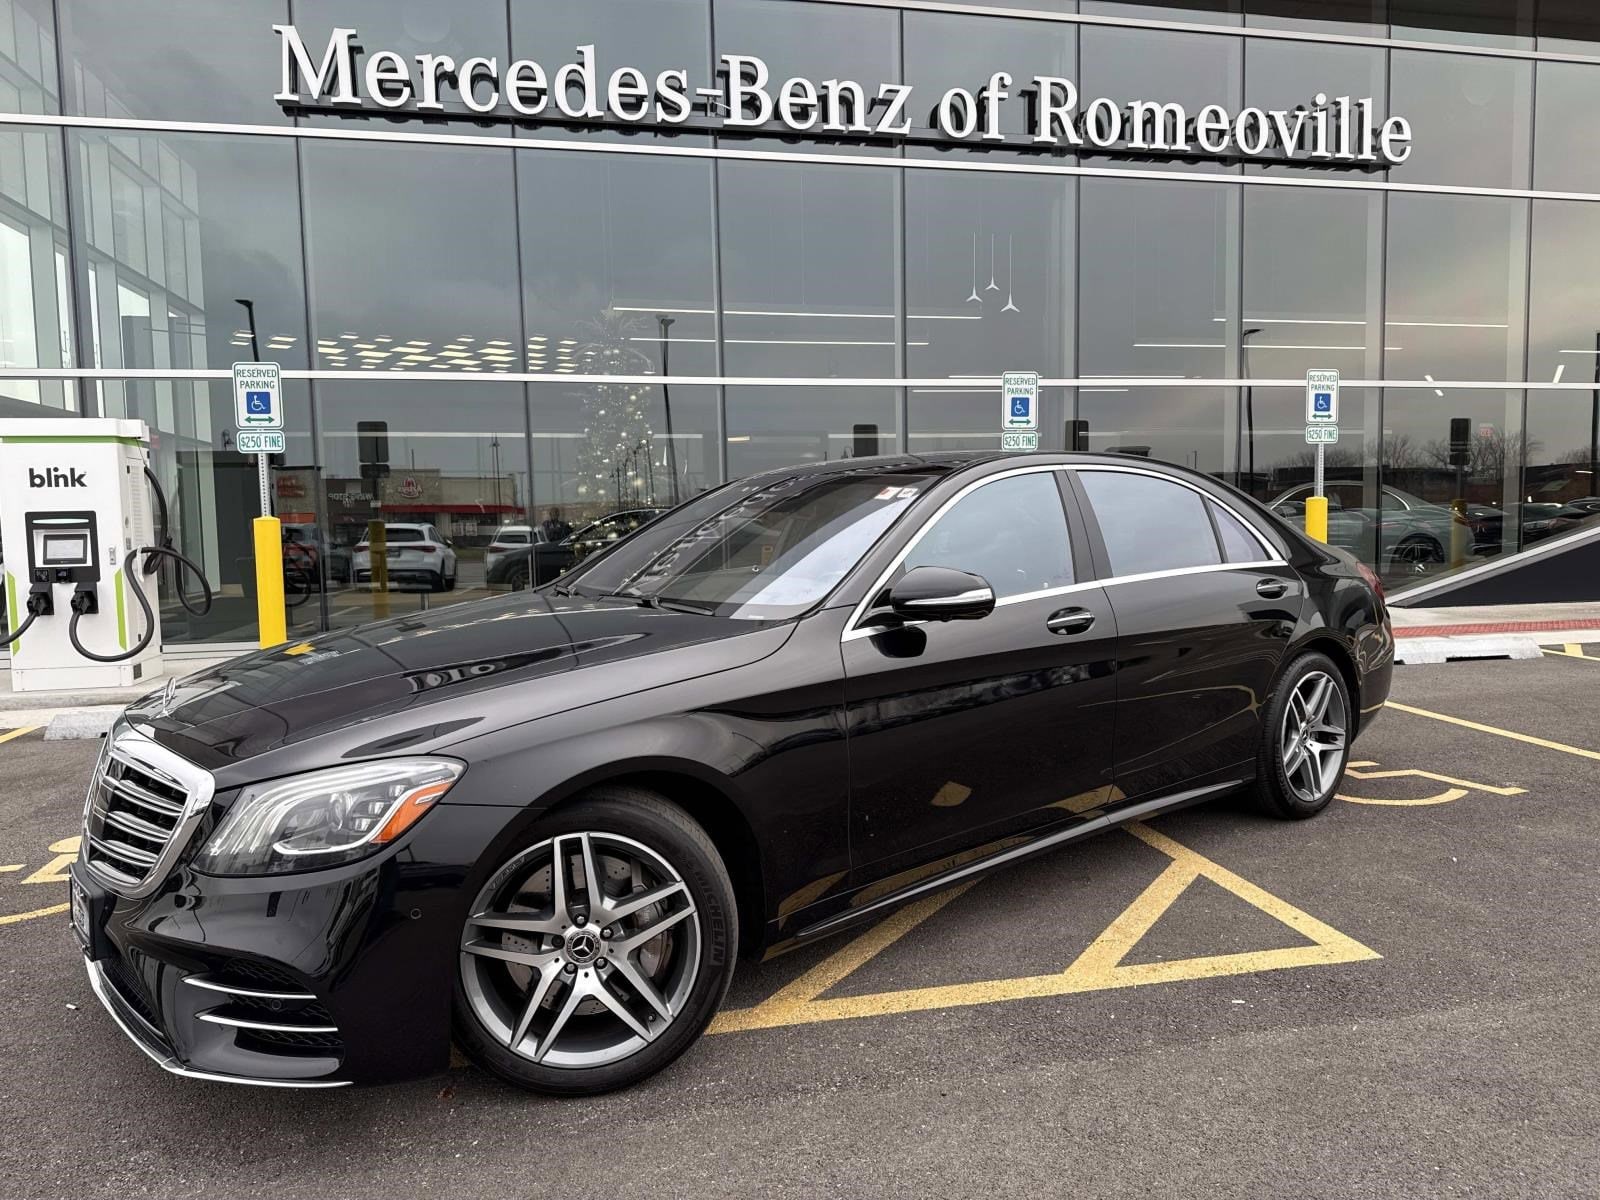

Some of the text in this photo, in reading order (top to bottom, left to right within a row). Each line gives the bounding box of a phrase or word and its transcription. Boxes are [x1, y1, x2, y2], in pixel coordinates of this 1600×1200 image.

[272, 24, 1412, 164] Mercedes-Benz of Romeoville
[236, 368, 277, 378] RESERVED
[1309, 374, 1337, 382] RESERVED
[239, 380, 275, 389] PARKING
[1005, 377, 1036, 386] RESERVED
[1007, 387, 1034, 395] PARKING
[1310, 383, 1335, 391] PARKING
[1308, 429, 1337, 440] $250 FINE
[240, 435, 282, 449] $250 FINE
[1004, 435, 1035, 447] $250 FINE
[28, 466, 88, 488] blink
[697, 873, 726, 966] MICHELIN
